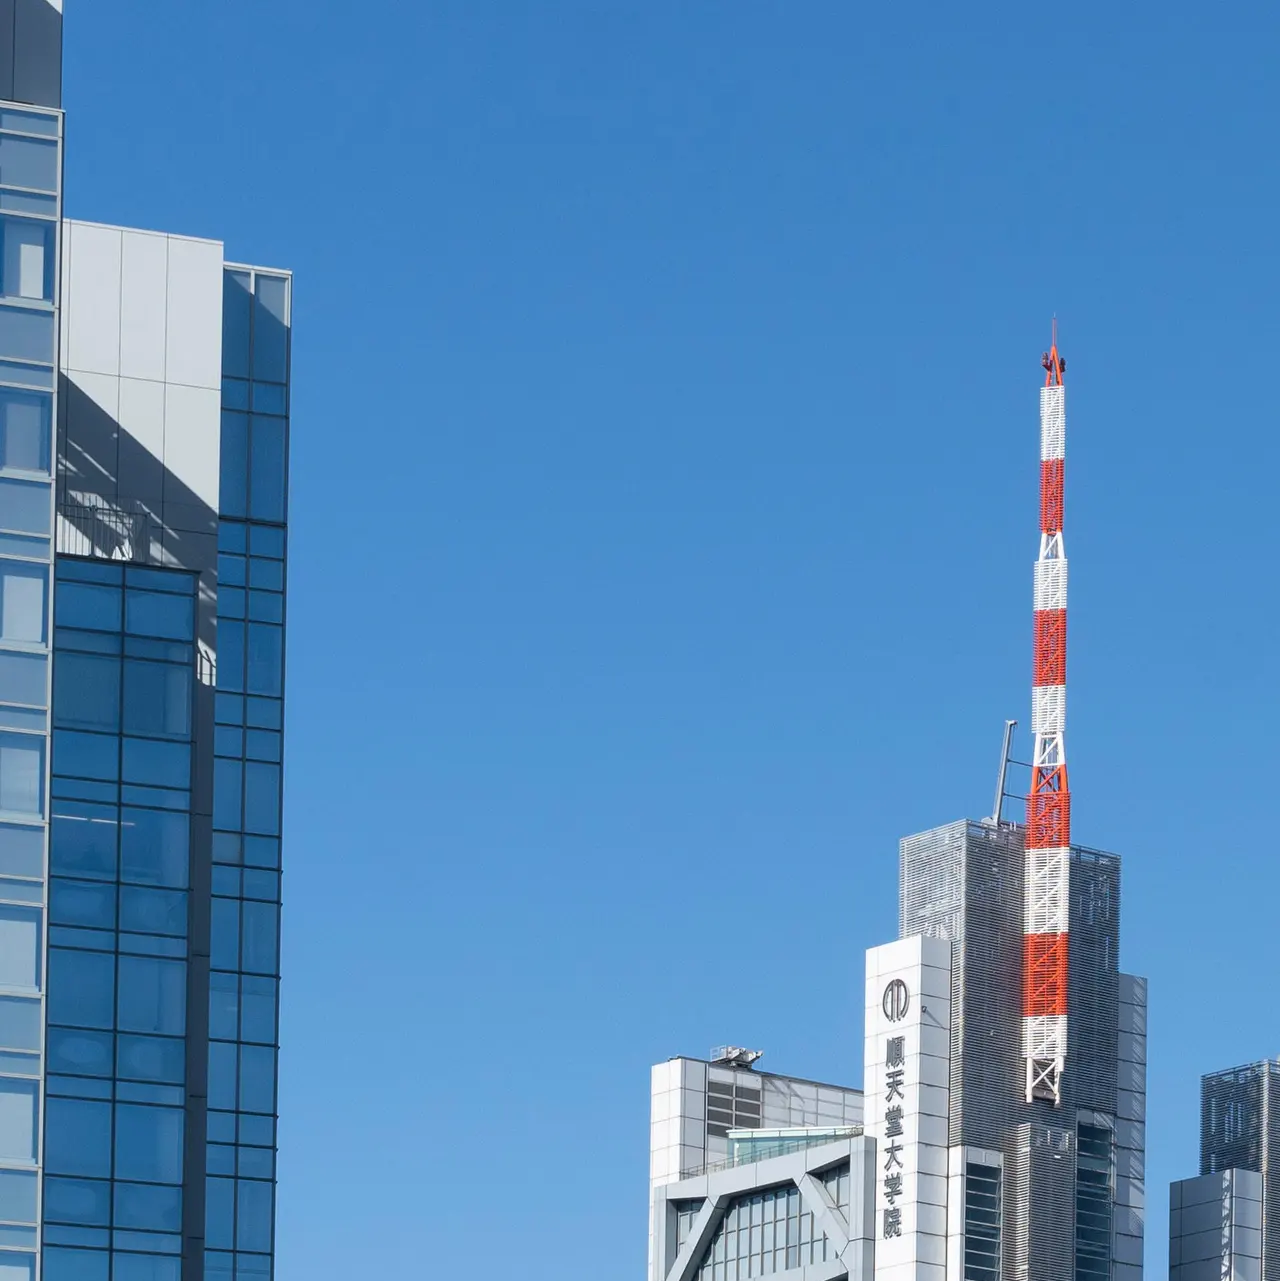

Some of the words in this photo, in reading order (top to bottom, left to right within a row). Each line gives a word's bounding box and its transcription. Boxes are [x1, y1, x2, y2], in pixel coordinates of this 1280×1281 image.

[883, 1036, 905, 1239] 順天堂大学院
